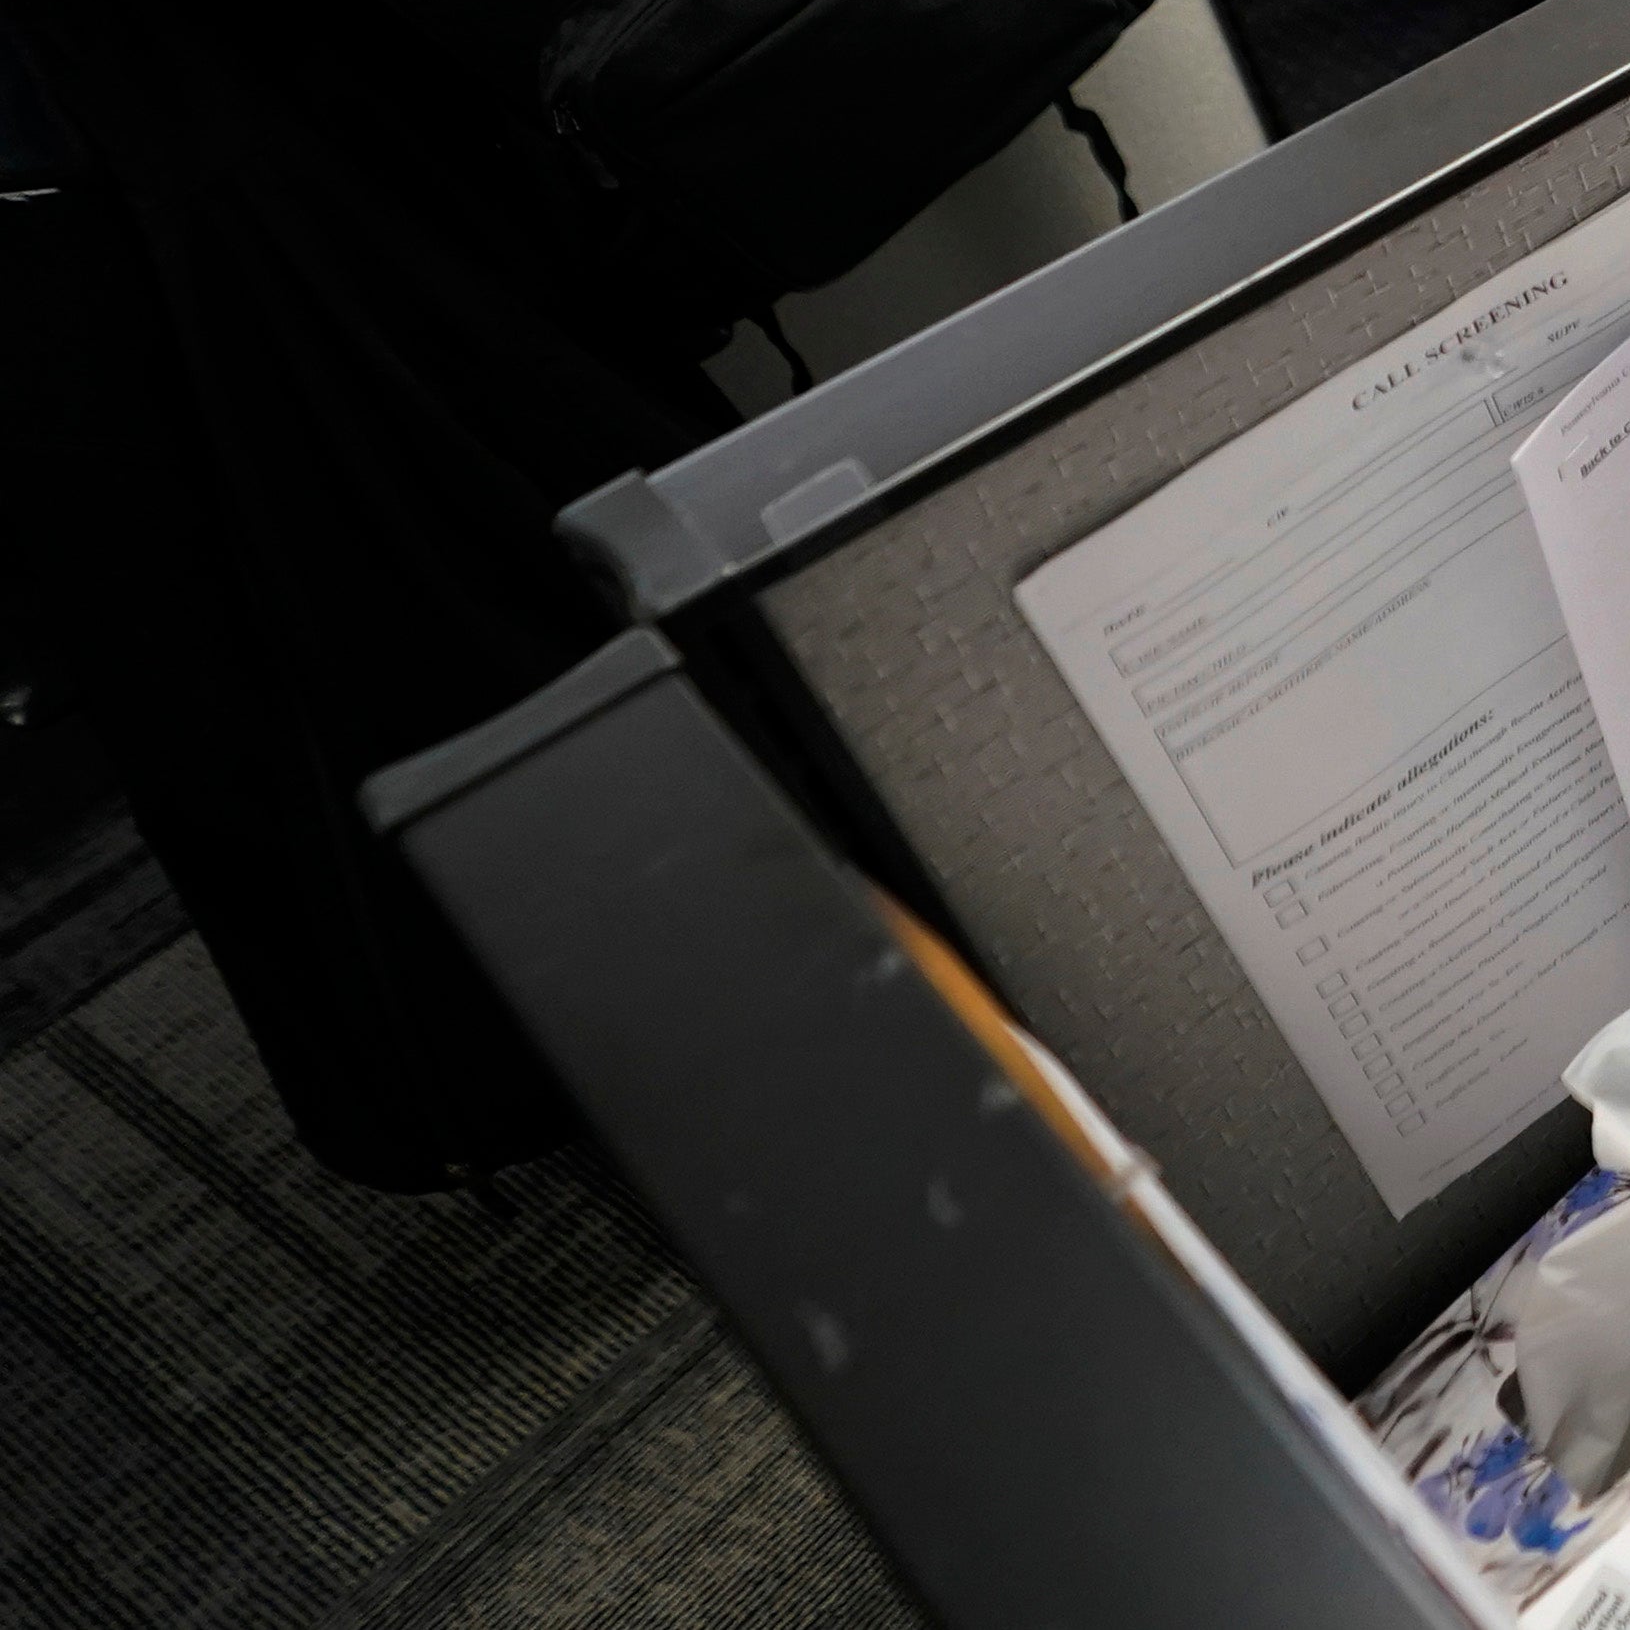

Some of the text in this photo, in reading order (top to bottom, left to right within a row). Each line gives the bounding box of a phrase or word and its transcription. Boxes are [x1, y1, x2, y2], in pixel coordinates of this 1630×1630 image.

[1350, 269, 1567, 412] CALL SCREENING
[1580, 445, 1610, 478] Back
[1610, 432, 1623, 449] to
[1316, 787, 1394, 846] indicate
[1393, 707, 1498, 792] allegations:
